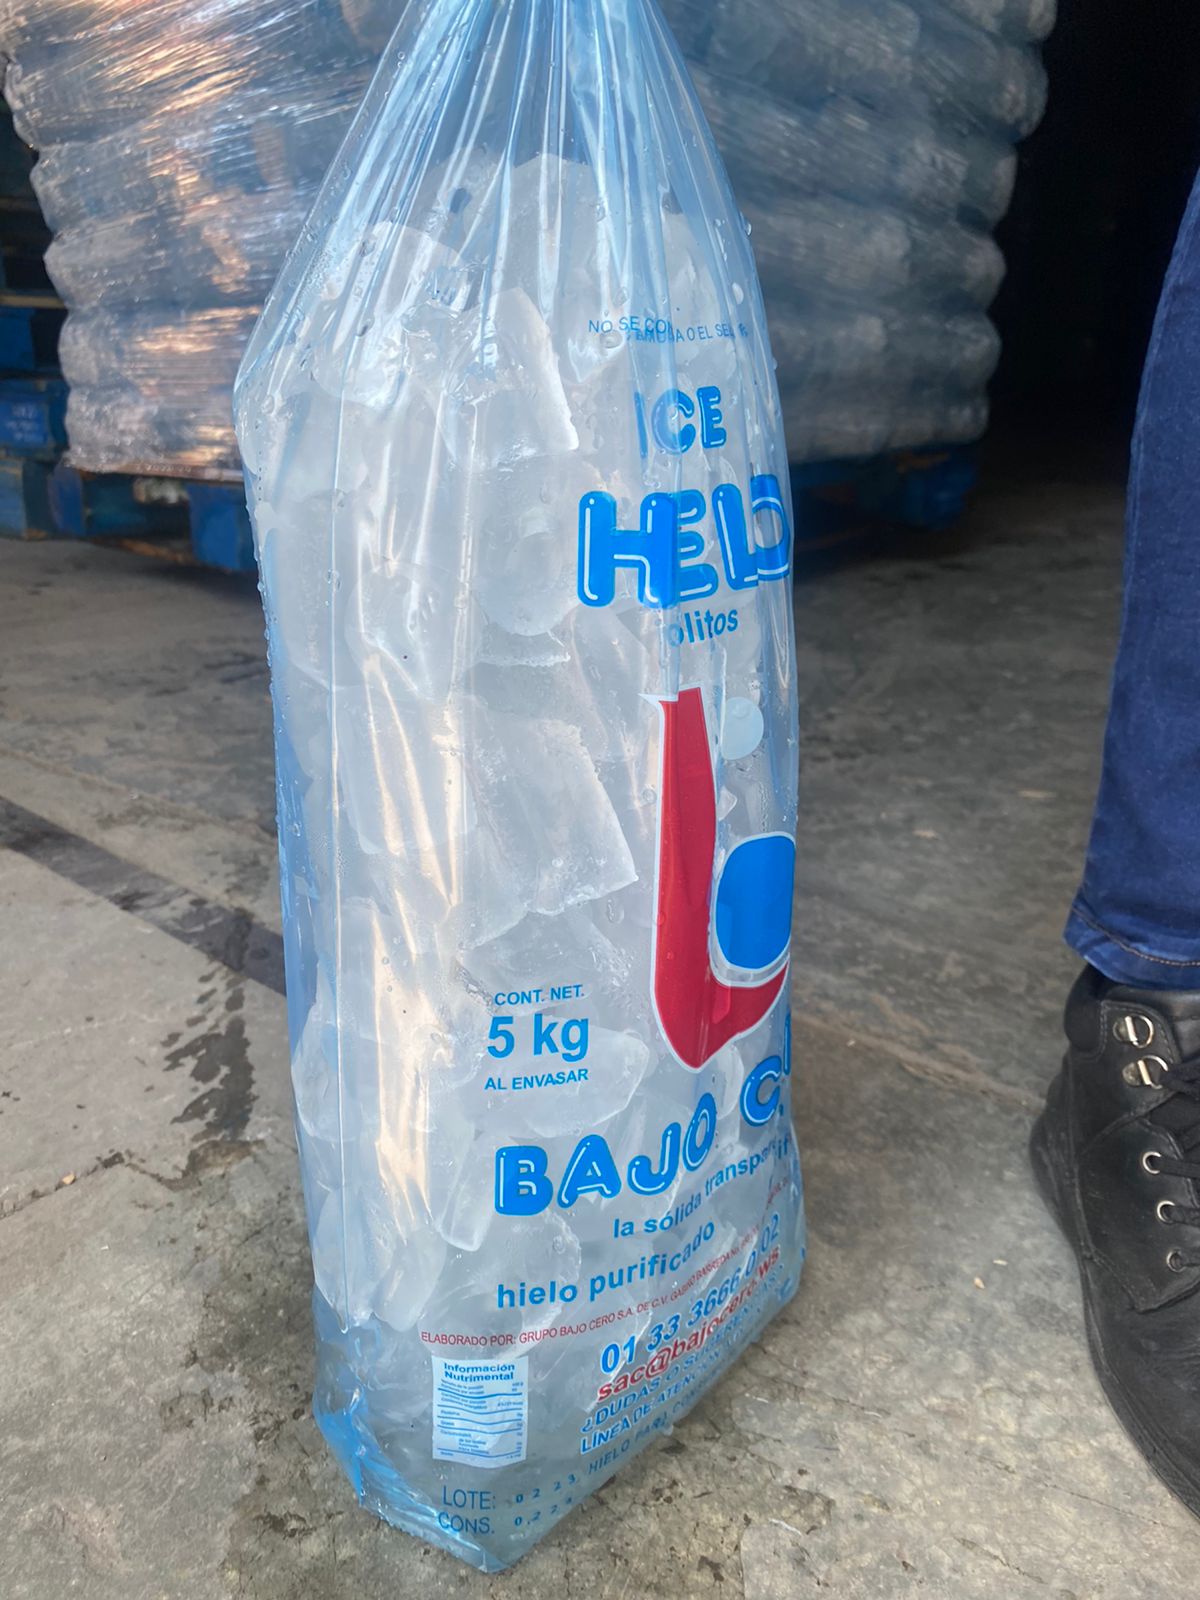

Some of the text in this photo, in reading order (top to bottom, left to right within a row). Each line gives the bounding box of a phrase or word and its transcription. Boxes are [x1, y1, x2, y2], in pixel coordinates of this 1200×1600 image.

[588, 319, 613, 333] NO
[619, 315, 640, 332] SE
[698, 325, 713, 341] EL
[633, 385, 728, 460] ICE
[494, 984, 585, 1006] CONT. NET.
[487, 1013, 590, 1063] 5 kg
[484, 1068, 589, 1091] AL ENVASAR
[494, 1092, 718, 1217] BAJO
[613, 1218, 635, 1239] la
[643, 1191, 702, 1234] sólida
[497, 1280, 578, 1309] hielo
[589, 1221, 715, 1302] purificado
[421, 1331, 488, 1347] ELABORADO
[490, 1335, 516, 1347] POR:
[519, 1327, 558, 1345] GRUPO
[560, 1322, 587, 1338] BAJO
[589, 1312, 616, 1331] CERO
[637, 1301, 649, 1314] DE
[600, 1334, 637, 1375] 01
[646, 1314, 681, 1351] 33
[687, 1266, 742, 1327] 3666
[443, 1362, 516, 1374] Información
[443, 1371, 515, 1383] Nutrimental
[581, 1376, 661, 1434] ¿DUDAS
[588, 1438, 630, 1475] HIELO
[442, 1485, 497, 1511] LOTE:
[437, 1511, 496, 1535] CONS.
